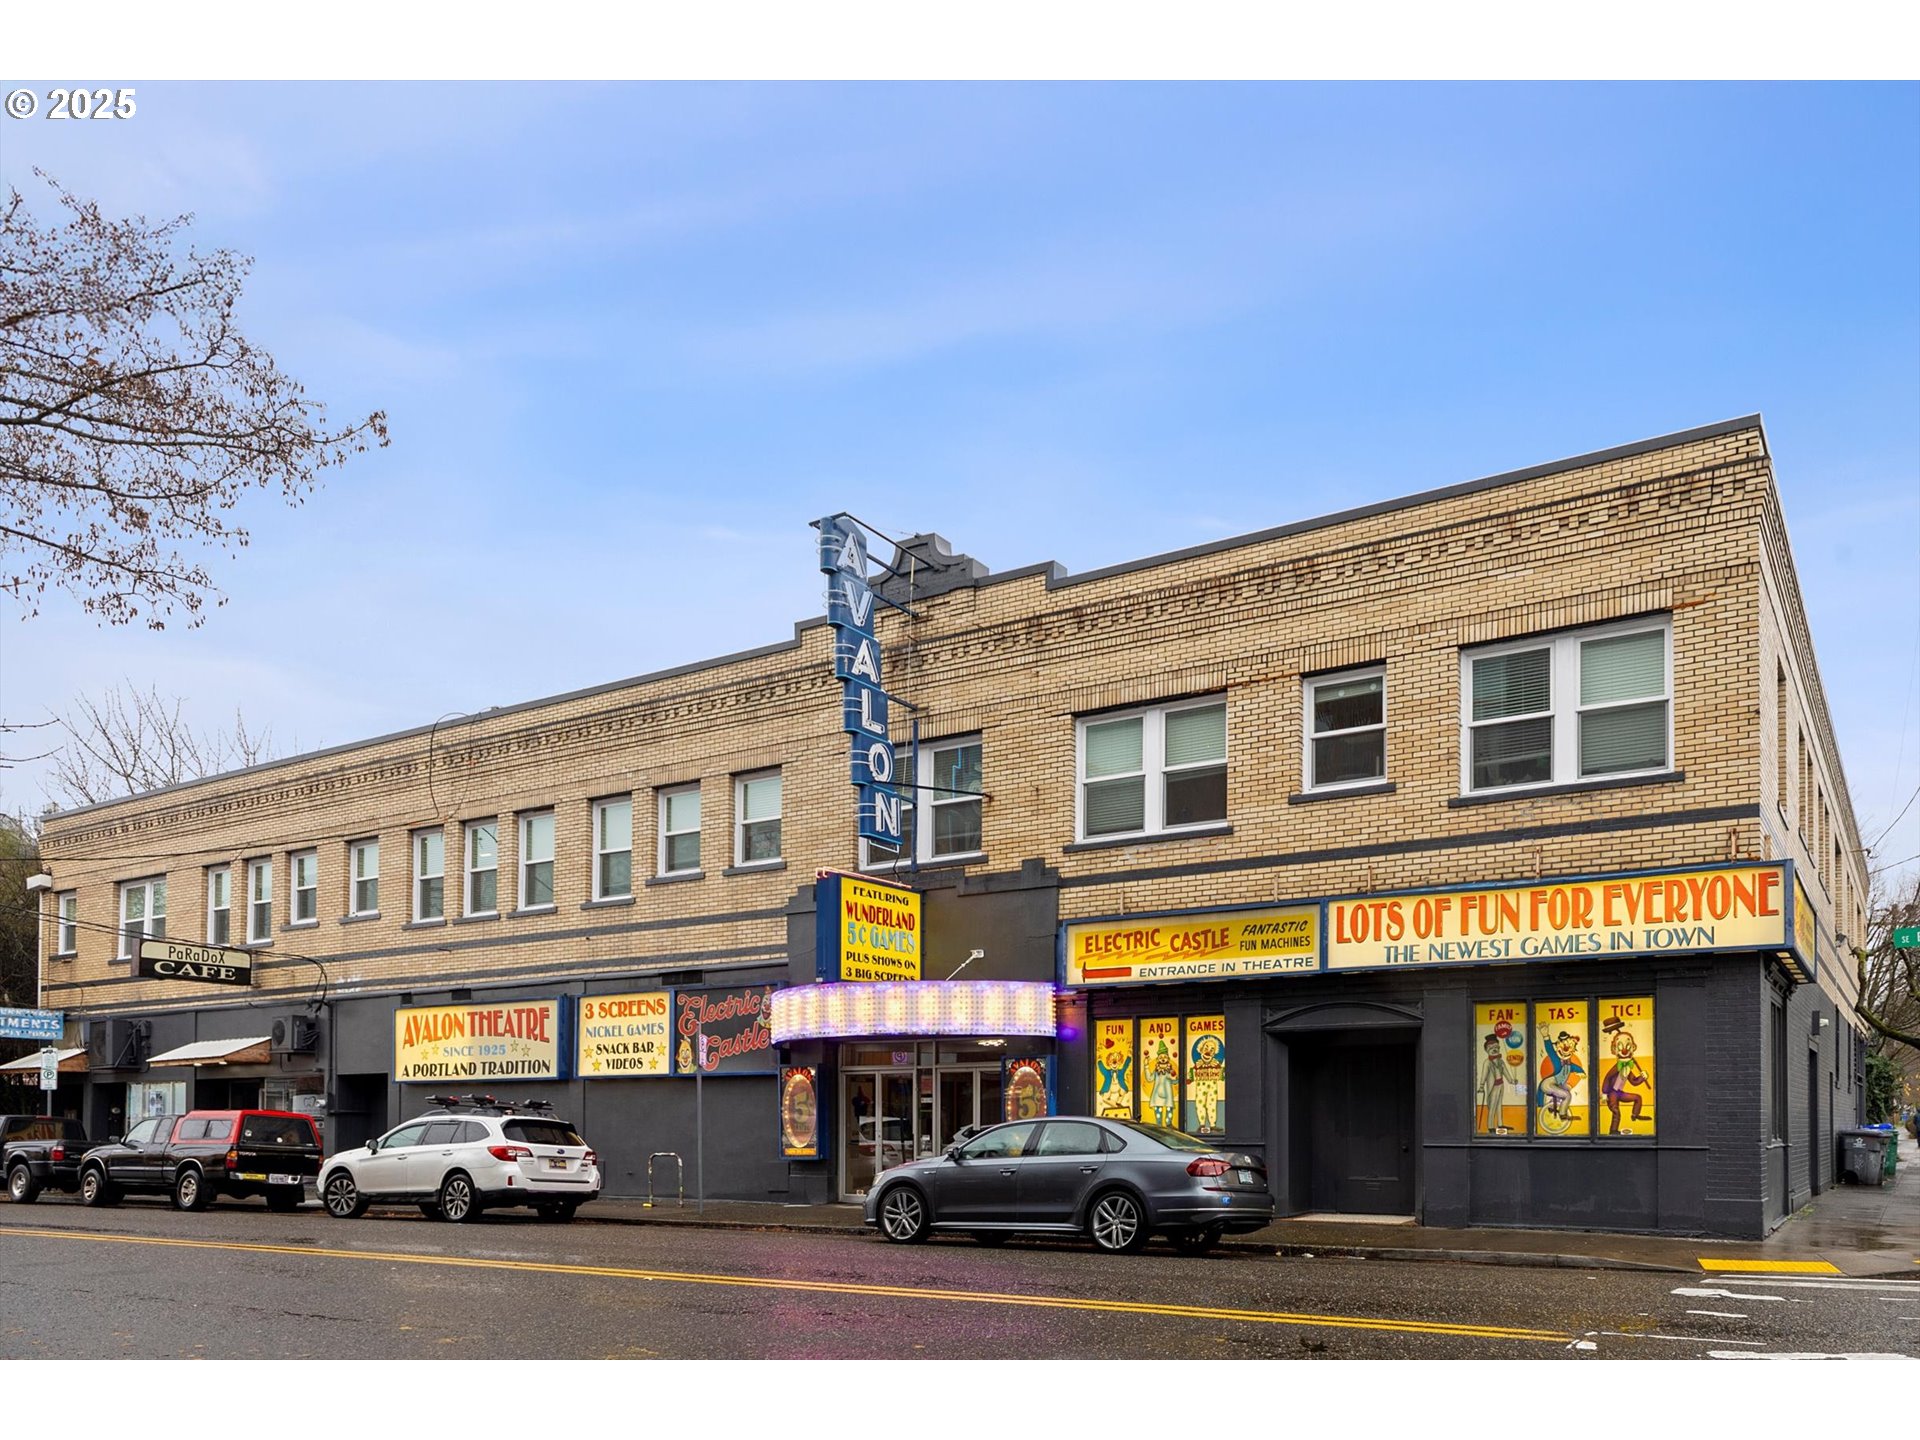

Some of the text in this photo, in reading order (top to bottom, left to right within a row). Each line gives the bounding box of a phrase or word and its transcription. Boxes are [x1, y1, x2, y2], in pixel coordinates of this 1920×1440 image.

[837, 531, 901, 837] AVALON
[853, 886, 909, 906] FEATURING
[845, 900, 915, 931] WUNDERLAND
[1336, 901, 1405, 944] LOTS
[1413, 898, 1452, 940] OF
[1460, 892, 1520, 936] FUN
[1530, 887, 1594, 932] FOR
[1603, 871, 1780, 928] EVERYONE
[1241, 920, 1309, 937] FANTASTIC
[870, 927, 915, 954] GAMES
[1085, 927, 1230, 954] ELECTRIC CASTLE
[1239, 935, 1311, 952] FUN MACHINES
[1384, 926, 1716, 963] THE NEWEST GAMES IN TOWN
[1901, 935, 1910, 944] SE
[168, 945, 226, 965] PaRaDoX
[846, 951, 916, 970] PLUS SHOWS ON
[153, 960, 237, 981] CAFE
[845, 966, 853, 977] 3
[855, 968, 872, 979] BIG
[1139, 956, 1315, 978] ENTRANCE IN THEATRE
[585, 998, 667, 1019] 3 SCREENS
[676, 989, 761, 1037] Electric
[1488, 1008, 1520, 1021] FAN-
[1548, 1007, 1580, 1020] TAS-
[1611, 1004, 1642, 1017] TIC!
[402, 1006, 550, 1050] AVALON THEATRE
[585, 1022, 665, 1038] NICKEL GAMES
[1105, 1024, 1125, 1035] FUN
[1148, 1022, 1172, 1034] AND
[1189, 1020, 1225, 1032] GAMES
[443, 1044, 507, 1057] SINCE 1925
[595, 1041, 655, 1055] SNACK BAR
[702, 1020, 770, 1072] Castle
[402, 1059, 551, 1077] A PORTLAND TRADITION
[605, 1057, 644, 1070] VIDEOS
